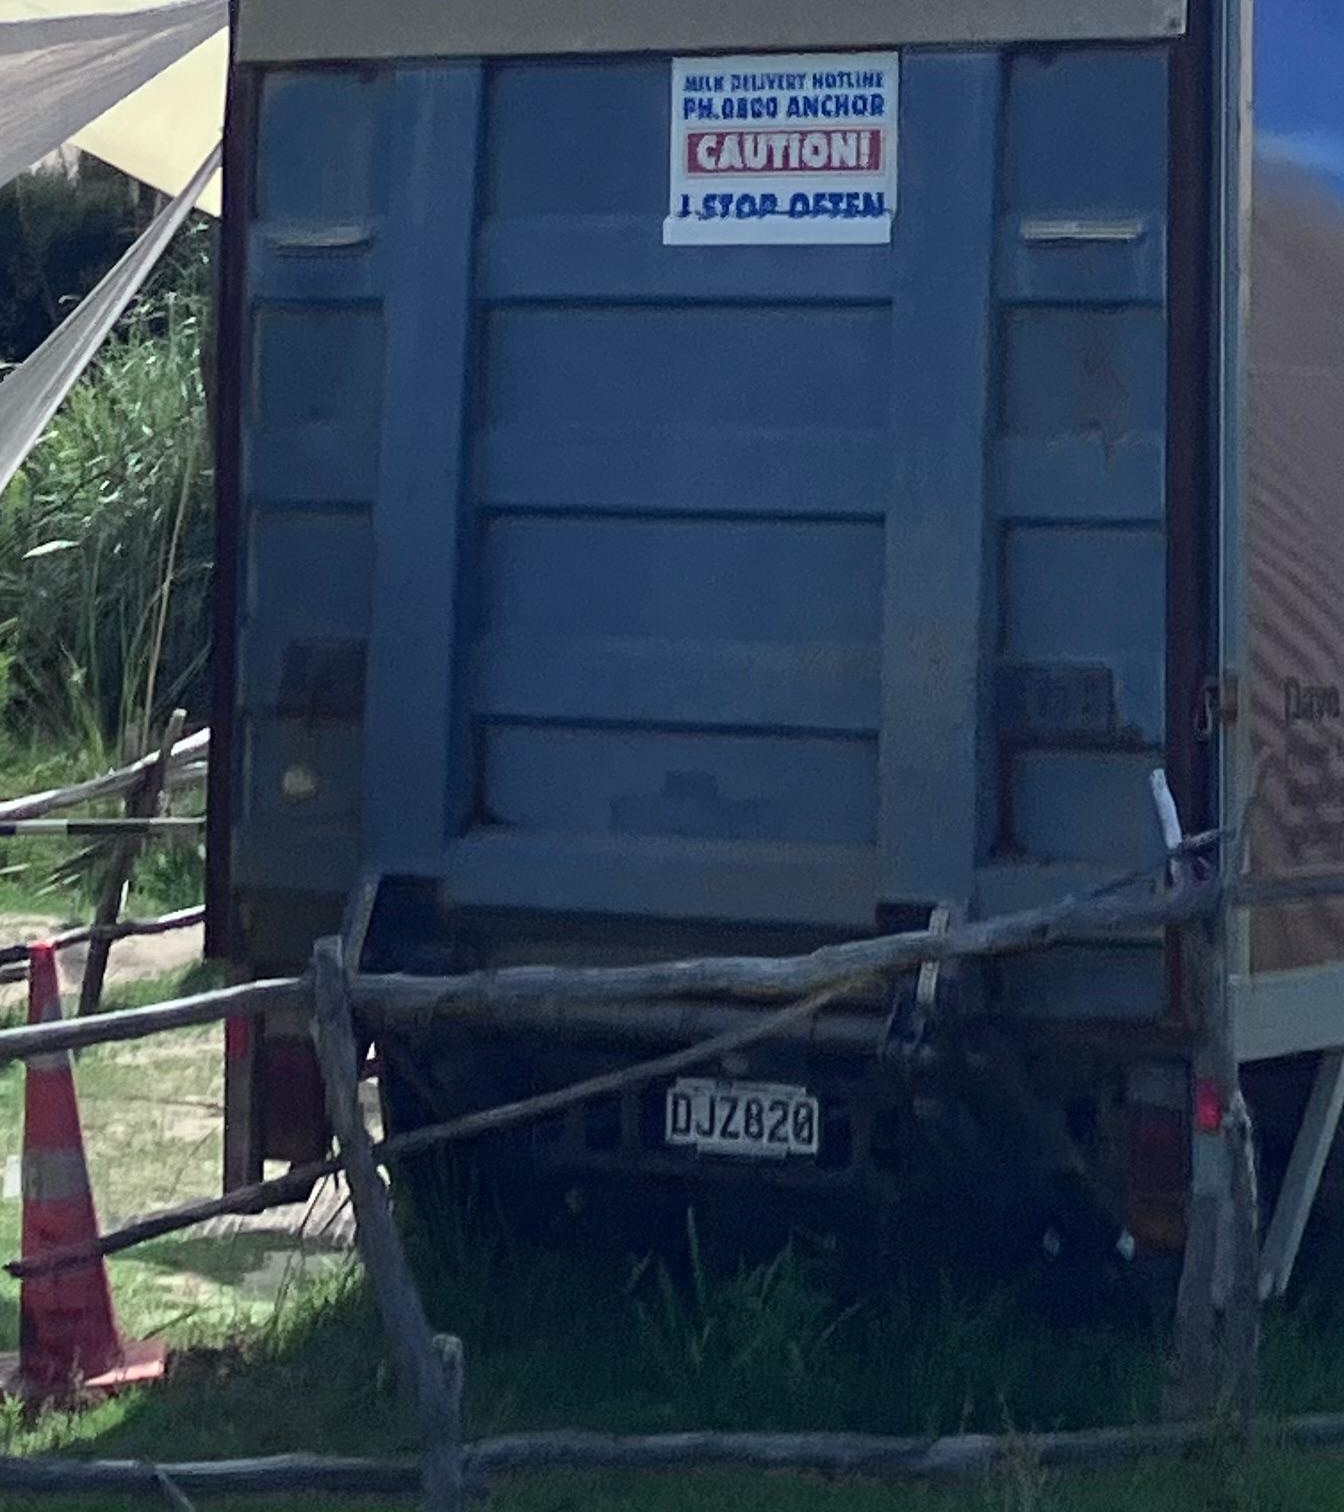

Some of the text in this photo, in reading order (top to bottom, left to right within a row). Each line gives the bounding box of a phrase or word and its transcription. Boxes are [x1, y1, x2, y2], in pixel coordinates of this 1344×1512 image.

[731, 71, 806, 92] DELIVERY
[812, 69, 885, 89] HOTLINE
[786, 93, 885, 119] ANCHOR
[696, 131, 872, 171] CAUTION!
[698, 192, 778, 220] STOP
[788, 191, 885, 219] OFTEN
[671, 1092, 814, 1146] DJZ820
